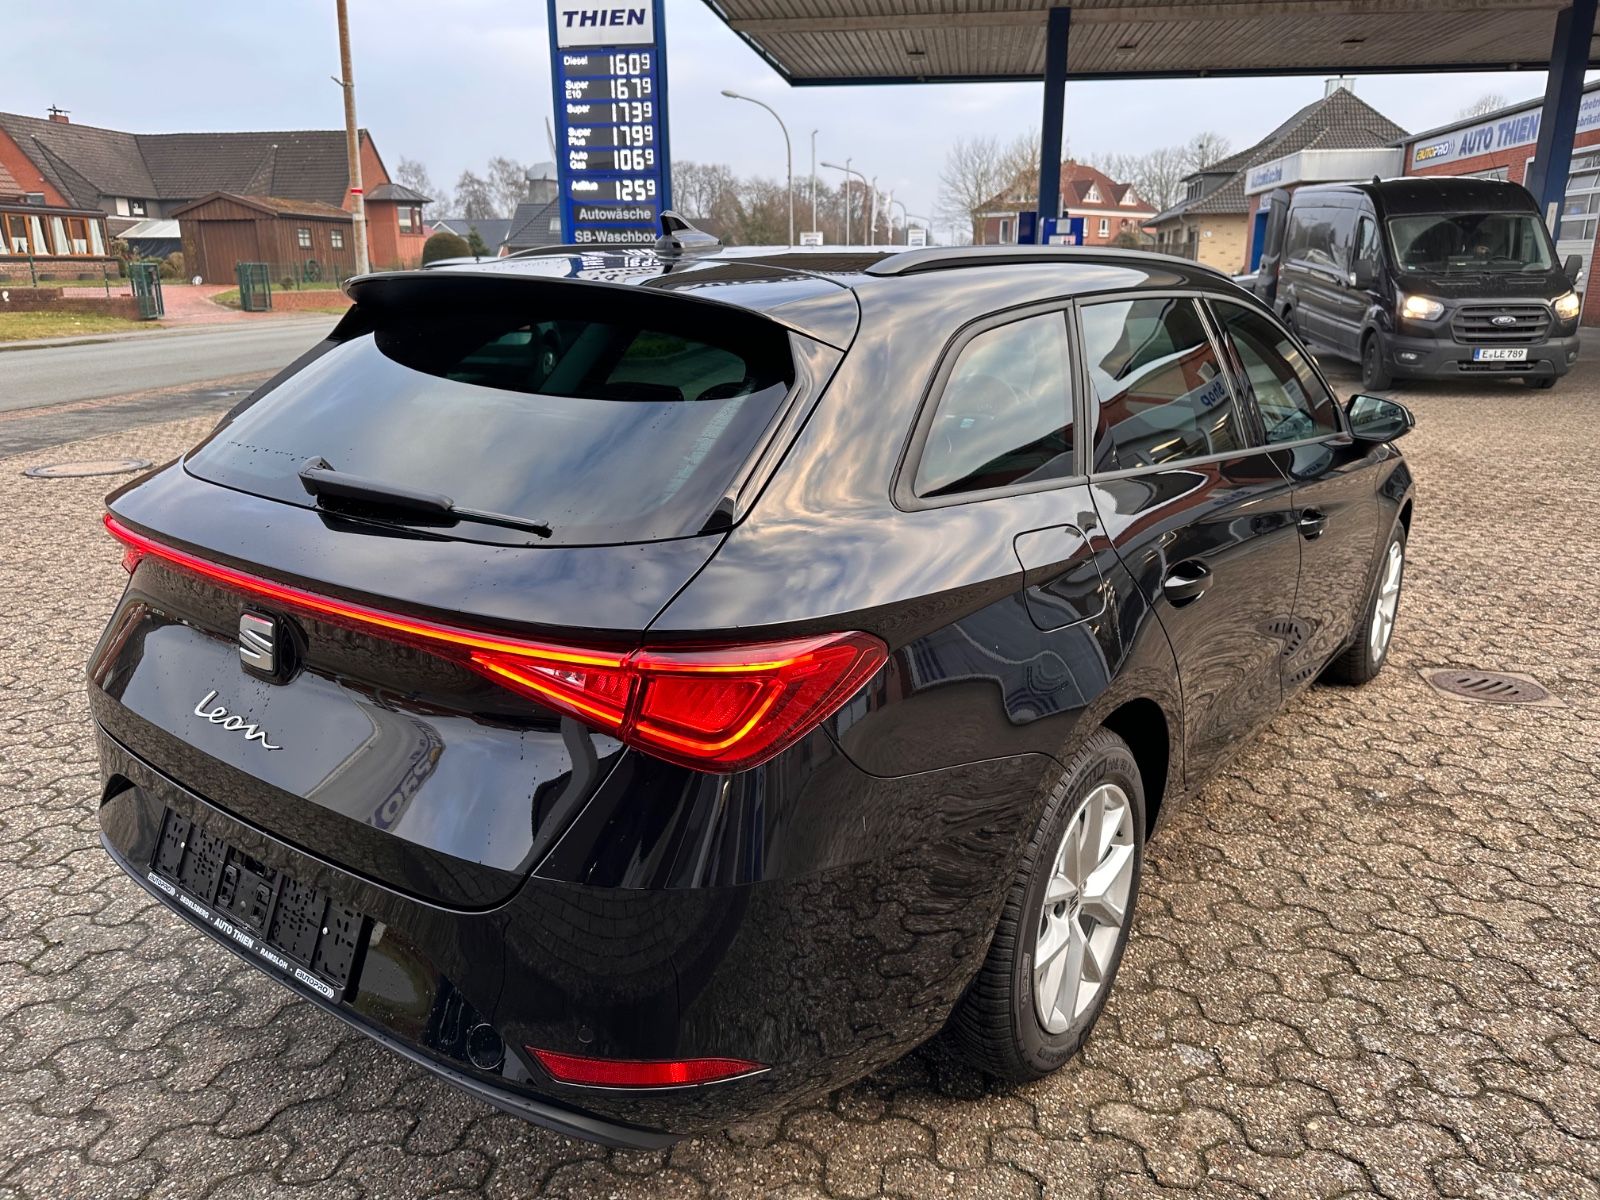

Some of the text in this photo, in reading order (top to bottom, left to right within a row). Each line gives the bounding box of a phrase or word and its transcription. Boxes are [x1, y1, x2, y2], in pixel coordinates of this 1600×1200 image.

[563, 8, 646, 27] THIEN
[563, 53, 650, 75] Diesel 1609
[565, 80, 589, 90] Super
[566, 90, 582, 99] E10
[611, 77, 652, 99] 1679
[567, 101, 652, 122] Super 1739
[568, 127, 591, 137] Super
[568, 136, 586, 146] Plus
[613, 125, 653, 146] 1799
[1459, 126, 1494, 156] AUTO
[1497, 114, 1540, 147] THIEN
[570, 150, 588, 160] Auto
[614, 149, 654, 170] 1069
[615, 179, 656, 201] 1259
[579, 208, 652, 220] Autowäsche
[574, 230, 656, 243] SB-Waschbox
[1507, 350, 1524, 358] 789
[194, 690, 280, 750] Leon
[180, 895, 209, 918] SEDELSBERG
[213, 918, 233, 934] AUTO
[233, 929, 255, 949] THIEN
[260, 948, 288, 969] RAMSLOH
